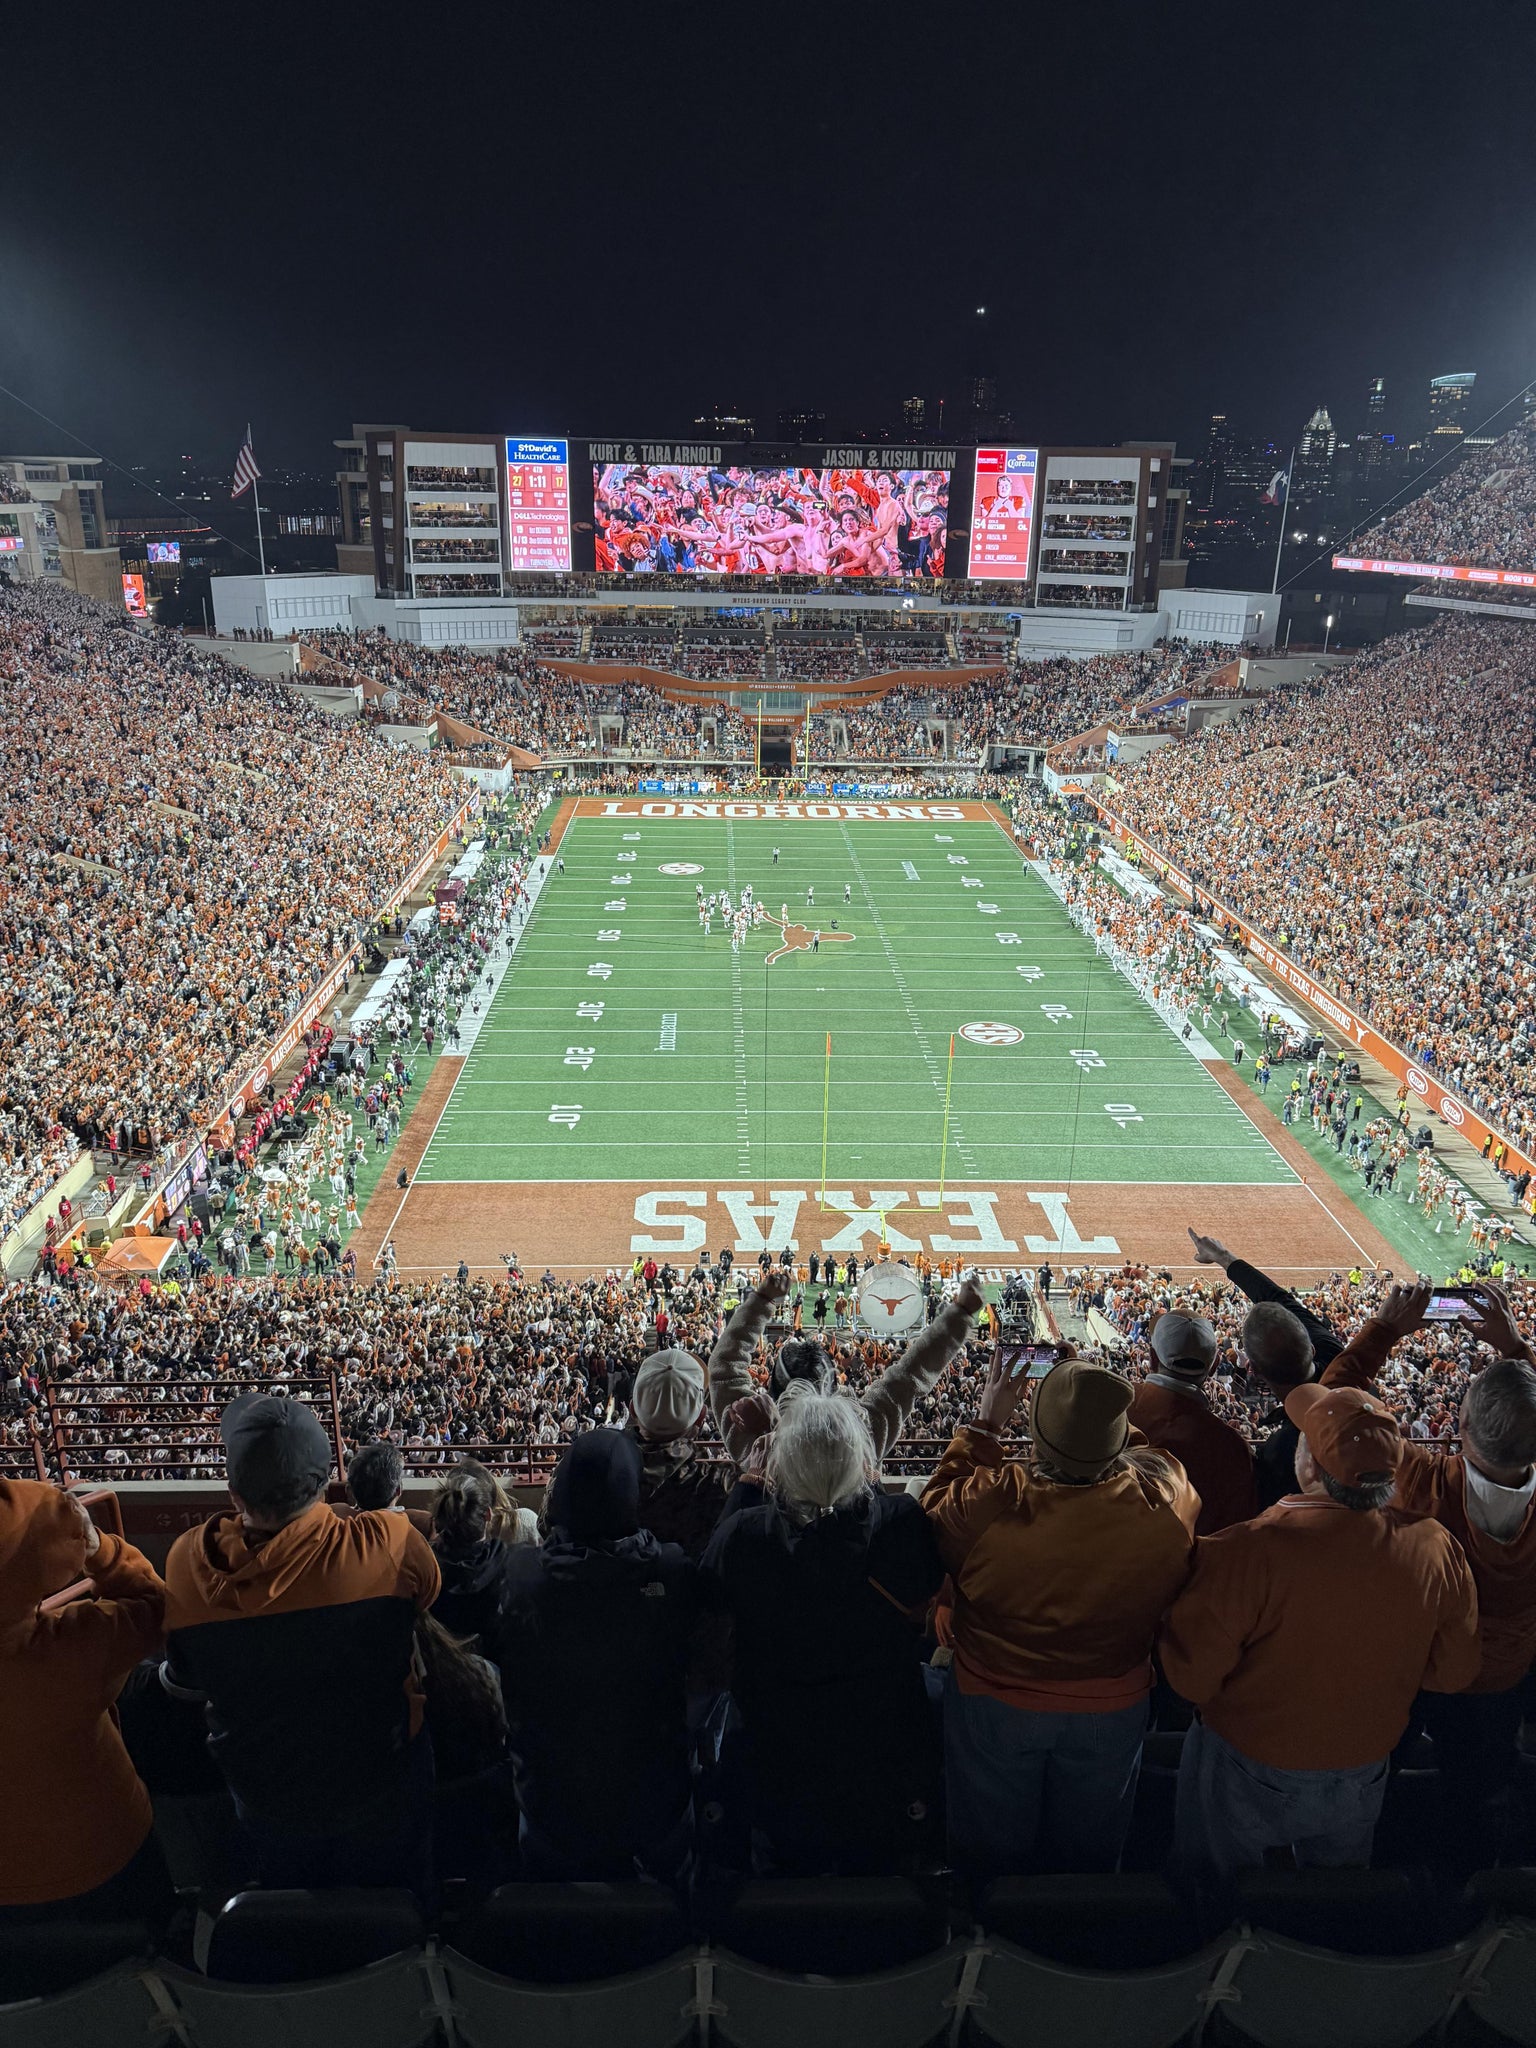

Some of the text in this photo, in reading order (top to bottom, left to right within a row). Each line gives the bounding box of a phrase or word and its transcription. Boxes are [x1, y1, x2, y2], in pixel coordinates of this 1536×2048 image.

[589, 443, 722, 464] KURT & TARA ARNOLD
[822, 449, 957, 469] JASON & KISHA ITKIN
[1007, 458, 1035, 469] Corona
[529, 475, 546, 488] 1:11
[974, 518, 986, 530] 54
[600, 802, 965, 820] LONGHORNS
[596, 929, 621, 941] 50
[995, 932, 1023, 944] 50
[586, 962, 614, 976] 40
[1016, 965, 1046, 979] 40
[1266, 951, 1276, 966] OF
[1275, 959, 1289, 978] THE
[1289, 968, 1311, 996] TEXAS
[1309, 987, 1352, 1031] LONGHORNS
[576, 1001, 605, 1016] 30
[1040, 1004, 1073, 1019] 30
[653, 1013, 678, 1051] humann
[563, 1047, 596, 1065] 20
[1069, 1049, 1107, 1067] 20
[548, 1104, 583, 1123] 10
[1103, 1104, 1145, 1122] 10
[630, 1190, 1121, 1254] TEXAS
